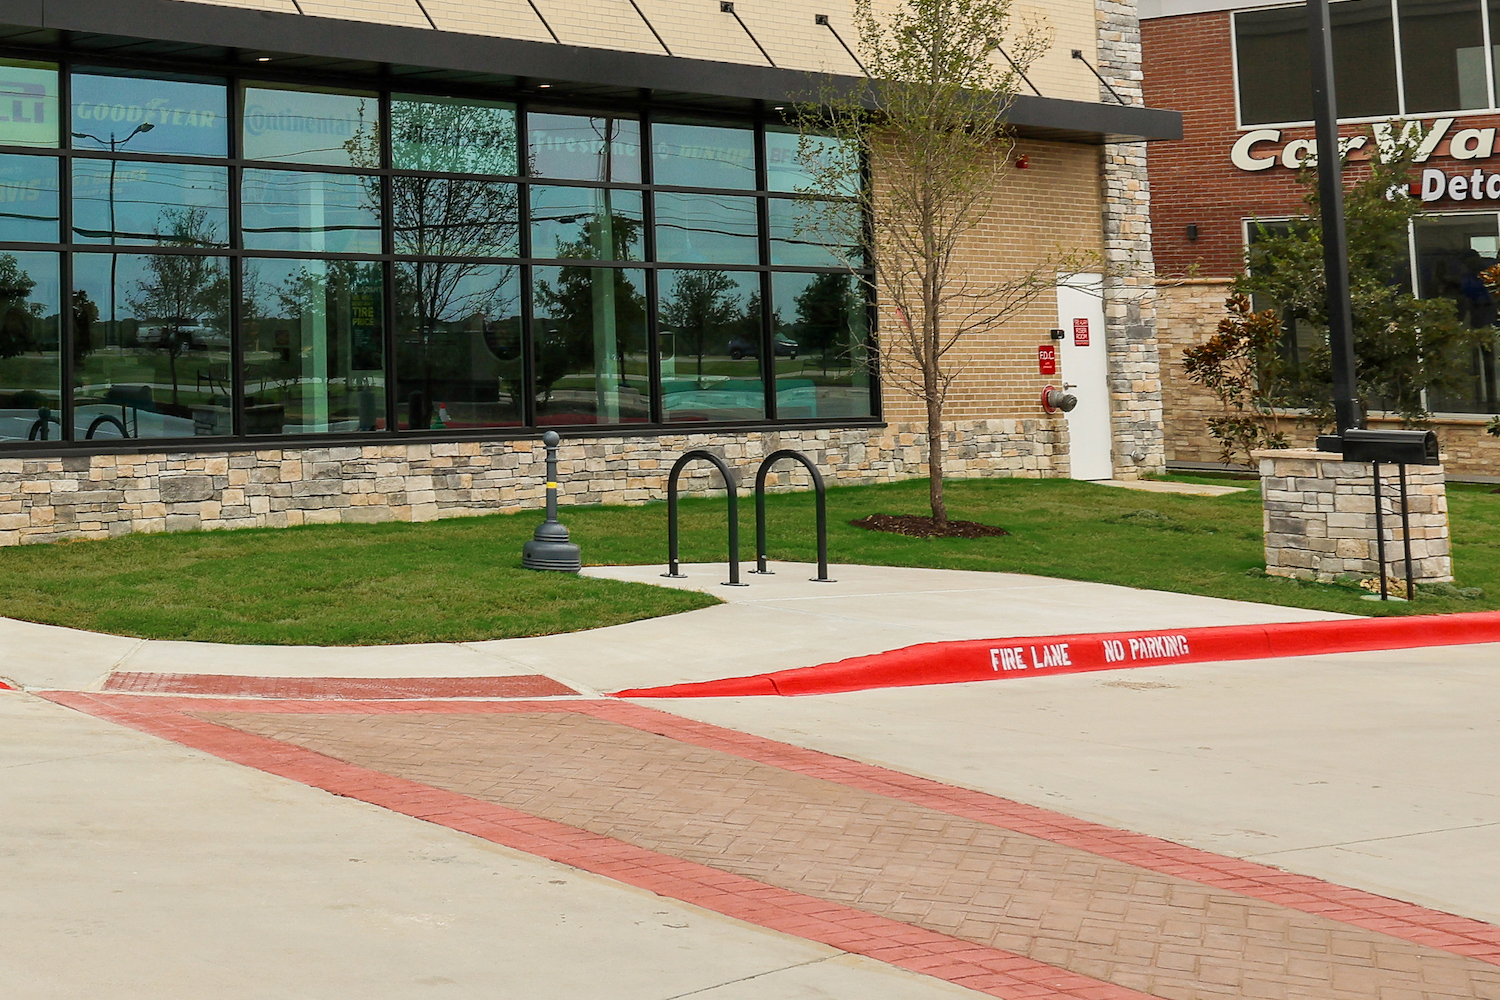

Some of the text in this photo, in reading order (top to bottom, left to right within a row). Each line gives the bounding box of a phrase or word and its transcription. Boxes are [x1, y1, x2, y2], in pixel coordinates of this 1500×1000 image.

[76, 99, 217, 129] GOODYEAR
[352, 306, 374, 317] TIRE
[990, 634, 1190, 671] FIRE LANE NO PARKING
